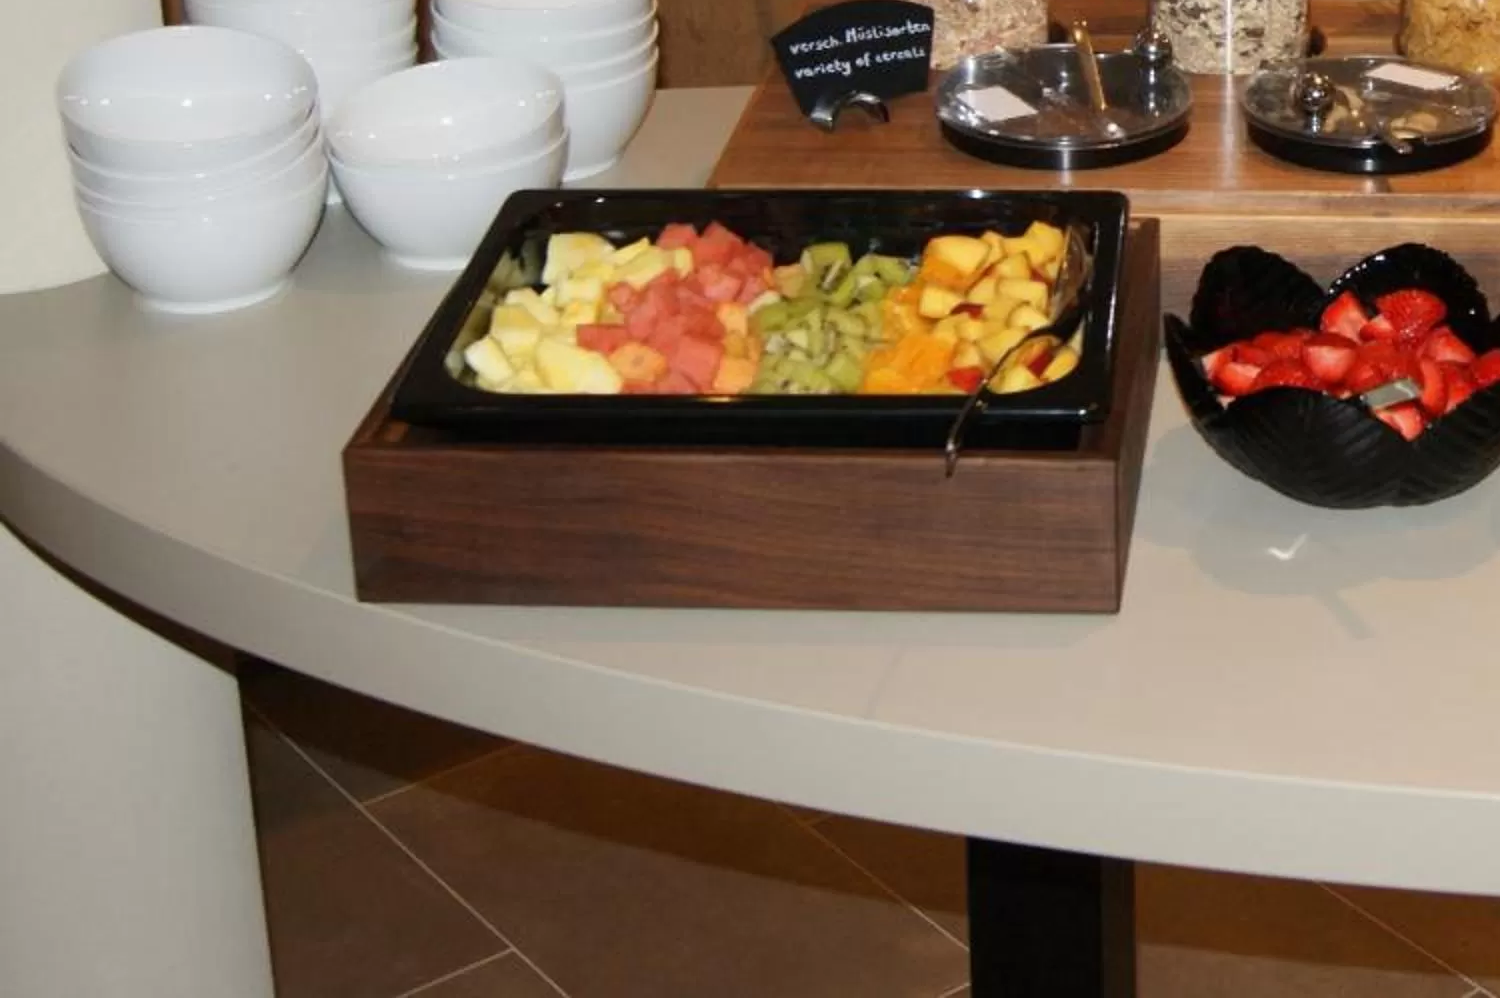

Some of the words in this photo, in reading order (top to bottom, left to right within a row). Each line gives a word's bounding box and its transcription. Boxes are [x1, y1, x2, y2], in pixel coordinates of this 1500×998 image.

[789, 35, 842, 55] versch.
[794, 59, 852, 79] variety
[855, 52, 871, 68] of
[875, 46, 926, 63] cereals
